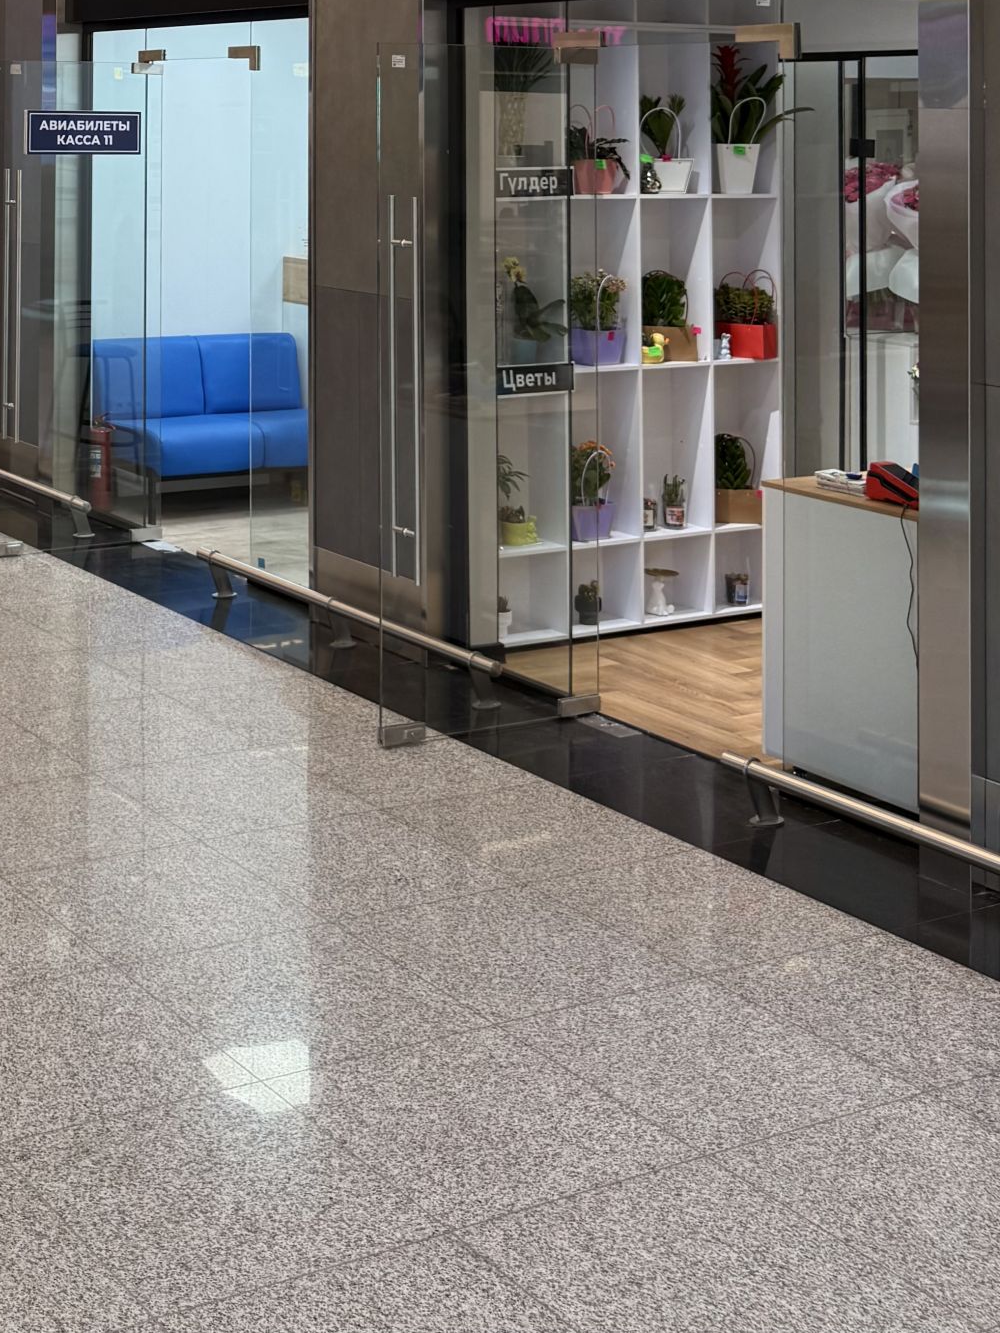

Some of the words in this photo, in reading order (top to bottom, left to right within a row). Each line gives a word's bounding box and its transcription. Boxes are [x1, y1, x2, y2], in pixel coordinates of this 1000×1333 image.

[39, 120, 130, 131] АВИАБИЛЕТЫ
[56, 134, 101, 145] КАССА
[103, 135, 113, 145] 11
[499, 173, 558, 194] Гүлдер
[502, 369, 557, 391] Цветы
